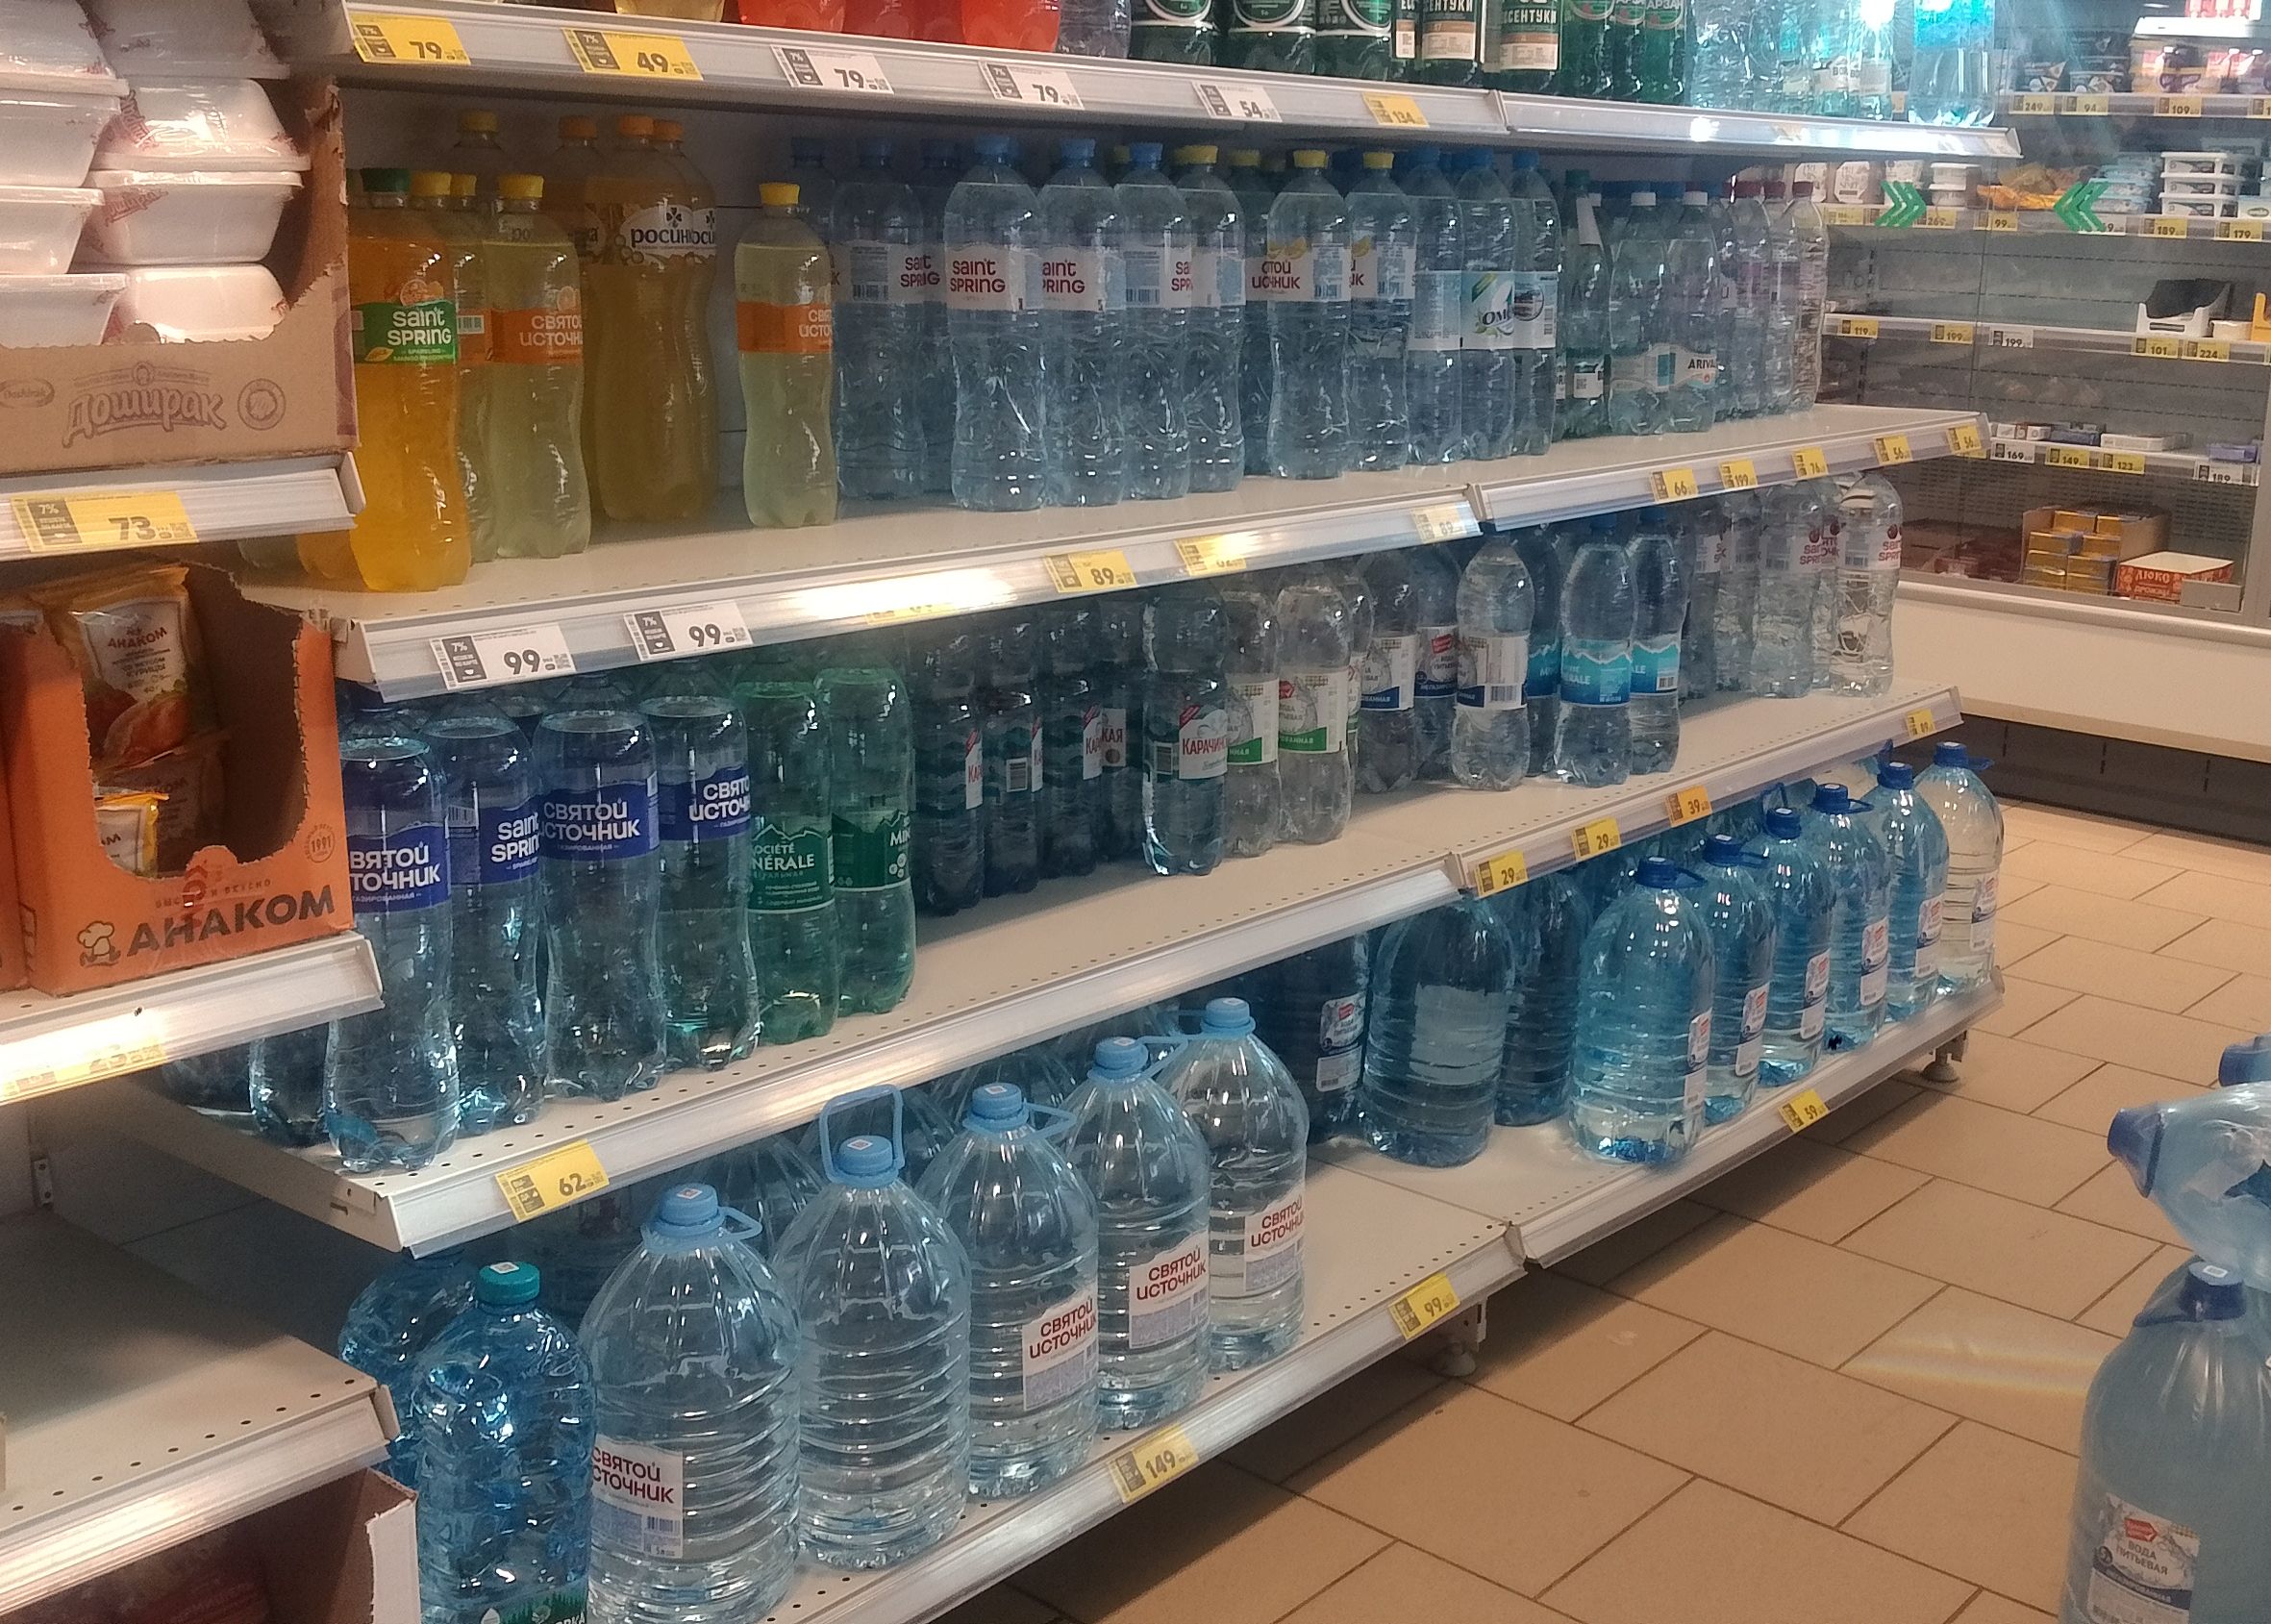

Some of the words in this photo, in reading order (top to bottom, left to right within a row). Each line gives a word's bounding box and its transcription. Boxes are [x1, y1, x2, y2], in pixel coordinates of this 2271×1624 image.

[409, 41, 441, 60] 79
[637, 52, 668, 73] 49
[834, 68, 864, 88] 79
[1032, 83, 1059, 103] 79
[1240, 100, 1263, 118] 54
[1392, 111, 1414, 124] 134
[2171, 106, 2190, 114] 109
[1994, 218, 2008, 227] 99
[2233, 229, 2252, 238] 179
[952, 258, 996, 276] saint
[950, 278, 1006, 293] SPRING
[392, 307, 445, 328] saint
[531, 313, 583, 331] СВЯТО
[387, 328, 452, 346] SPRING
[1854, 326, 1869, 335] 119
[1946, 331, 1962, 340] 199
[2150, 345, 2168, 355] 101
[2199, 349, 2218, 359] 224
[62, 387, 228, 448] Доширак
[2061, 456, 2080, 465] 149
[1674, 482, 1687, 495] 66
[38, 504, 60, 514] 7%
[108, 516, 156, 541] 73
[1090, 567, 1114, 586] 89
[108, 626, 167, 648] АНАКОМ
[688, 624, 721, 647] 99
[503, 649, 540, 675] 99
[543, 797, 628, 820] СВЯТОЙ
[1687, 798, 1701, 814] 39
[1595, 833, 1610, 850] 29
[1501, 866, 1515, 886] 29
[127, 884, 336, 958] АНАКОМ
[1804, 1104, 1818, 1120] 59
[558, 1172, 586, 1197] 62
[1148, 1244, 1201, 1282] СВЯТОЙ
[1136, 1262, 1207, 1301] ИСТОЧНИК
[1040, 1295, 1093, 1337] СВЯТОЙ
[1424, 1296, 1442, 1318] 99
[591, 1446, 661, 1483] СВЯТОЙ
[1145, 1448, 1177, 1480] 149
[2115, 1544, 2169, 1575] ПИТЬЕВАЯ
[2127, 1541, 2158, 1560] ВОДА
